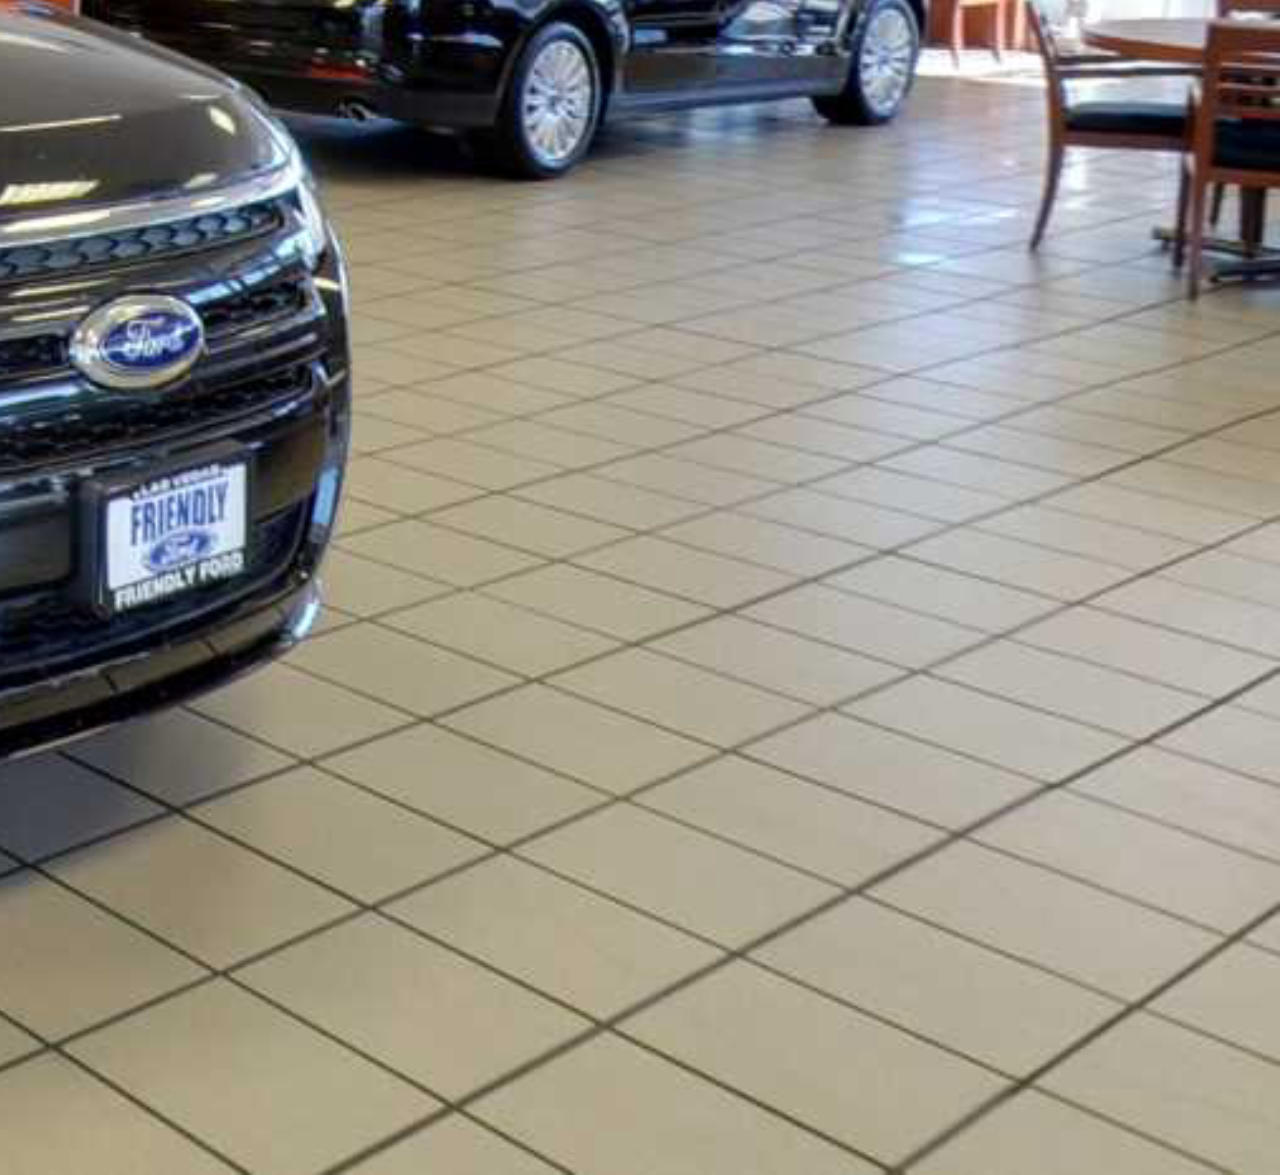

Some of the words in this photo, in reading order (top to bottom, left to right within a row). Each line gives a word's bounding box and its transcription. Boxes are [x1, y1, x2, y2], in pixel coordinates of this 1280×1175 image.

[122, 314, 186, 360] Ford
[130, 480, 229, 547] FRIENDLY
[114, 562, 197, 612] FRIENDLY
[198, 551, 245, 582] FORD
